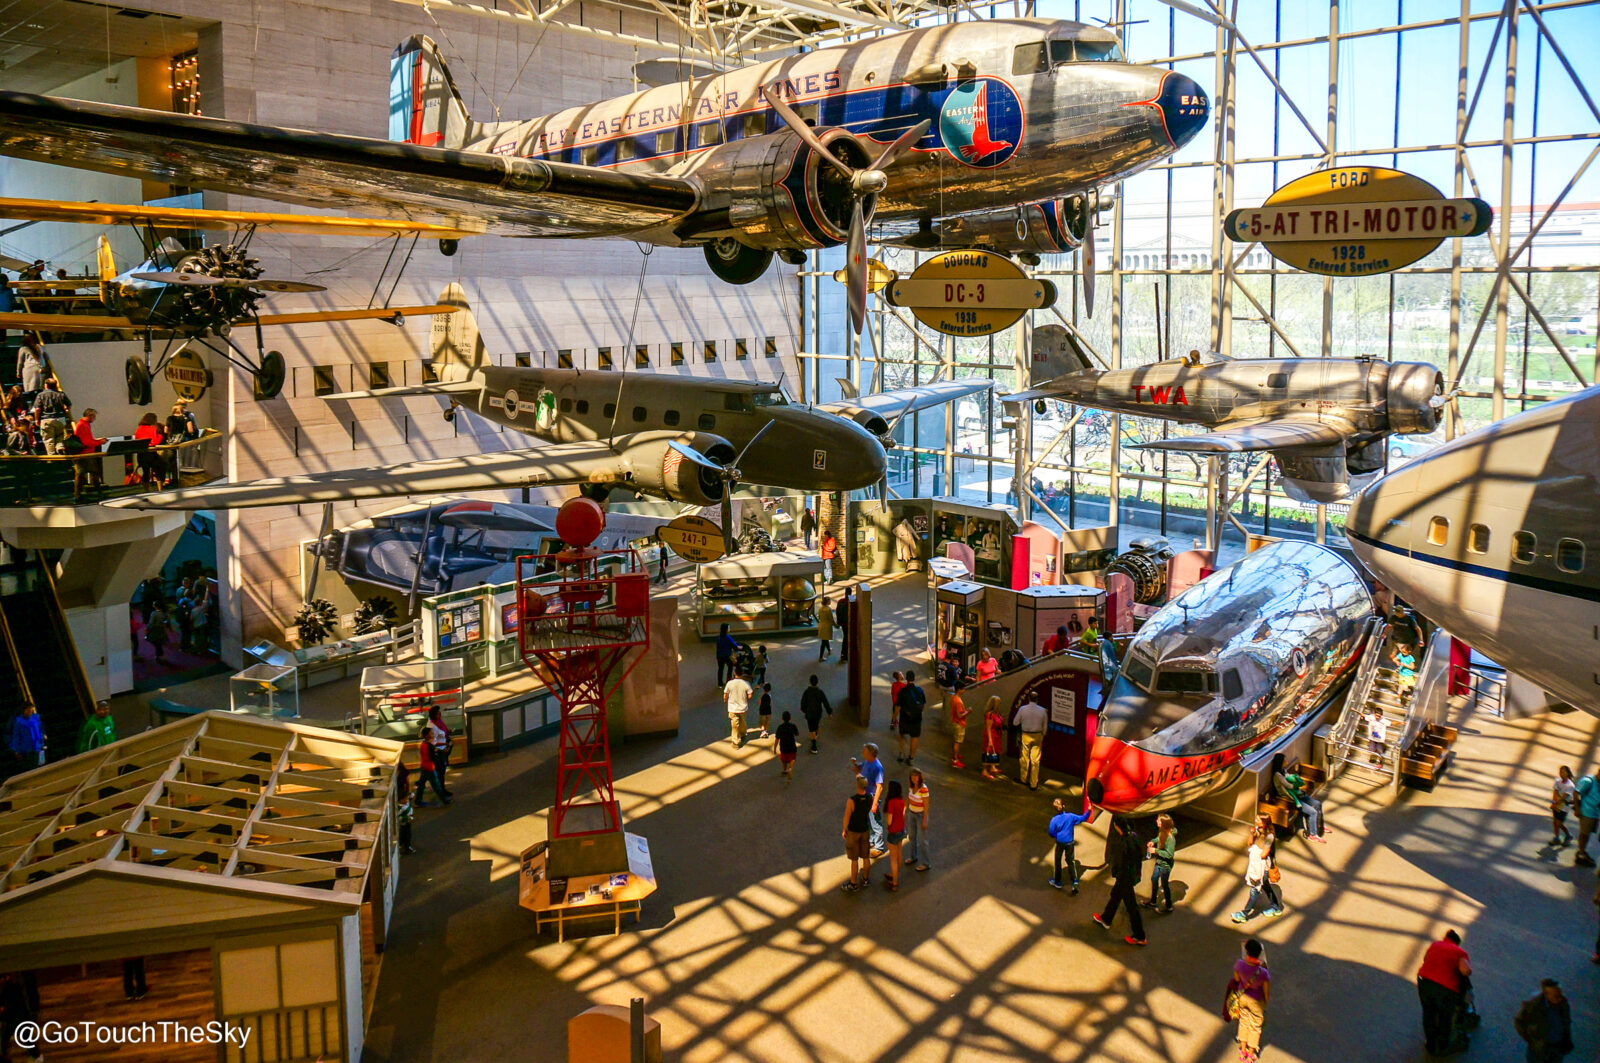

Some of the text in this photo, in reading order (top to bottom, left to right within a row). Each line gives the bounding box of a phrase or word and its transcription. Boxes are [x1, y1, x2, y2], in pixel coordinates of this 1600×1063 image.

[538, 128, 569, 148] FLY
[581, 103, 681, 139] EASTERN
[757, 69, 841, 103] LINES
[946, 105, 984, 117] EASTERN
[1330, 171, 1369, 188] FORD
[1251, 205, 1458, 236] 5-AT TRI-MOTOR
[1332, 245, 1366, 260] 1928
[944, 254, 988, 269] DOUGLAS
[1308, 257, 1390, 273] Entered Service
[944, 283, 985, 303] DC-3
[955, 311, 977, 323] 1936
[939, 320, 992, 334] Entered Service
[1131, 385, 1188, 406] TWA
[681, 532, 707, 546] 247-D
[1144, 752, 1226, 790] AMERICAN
